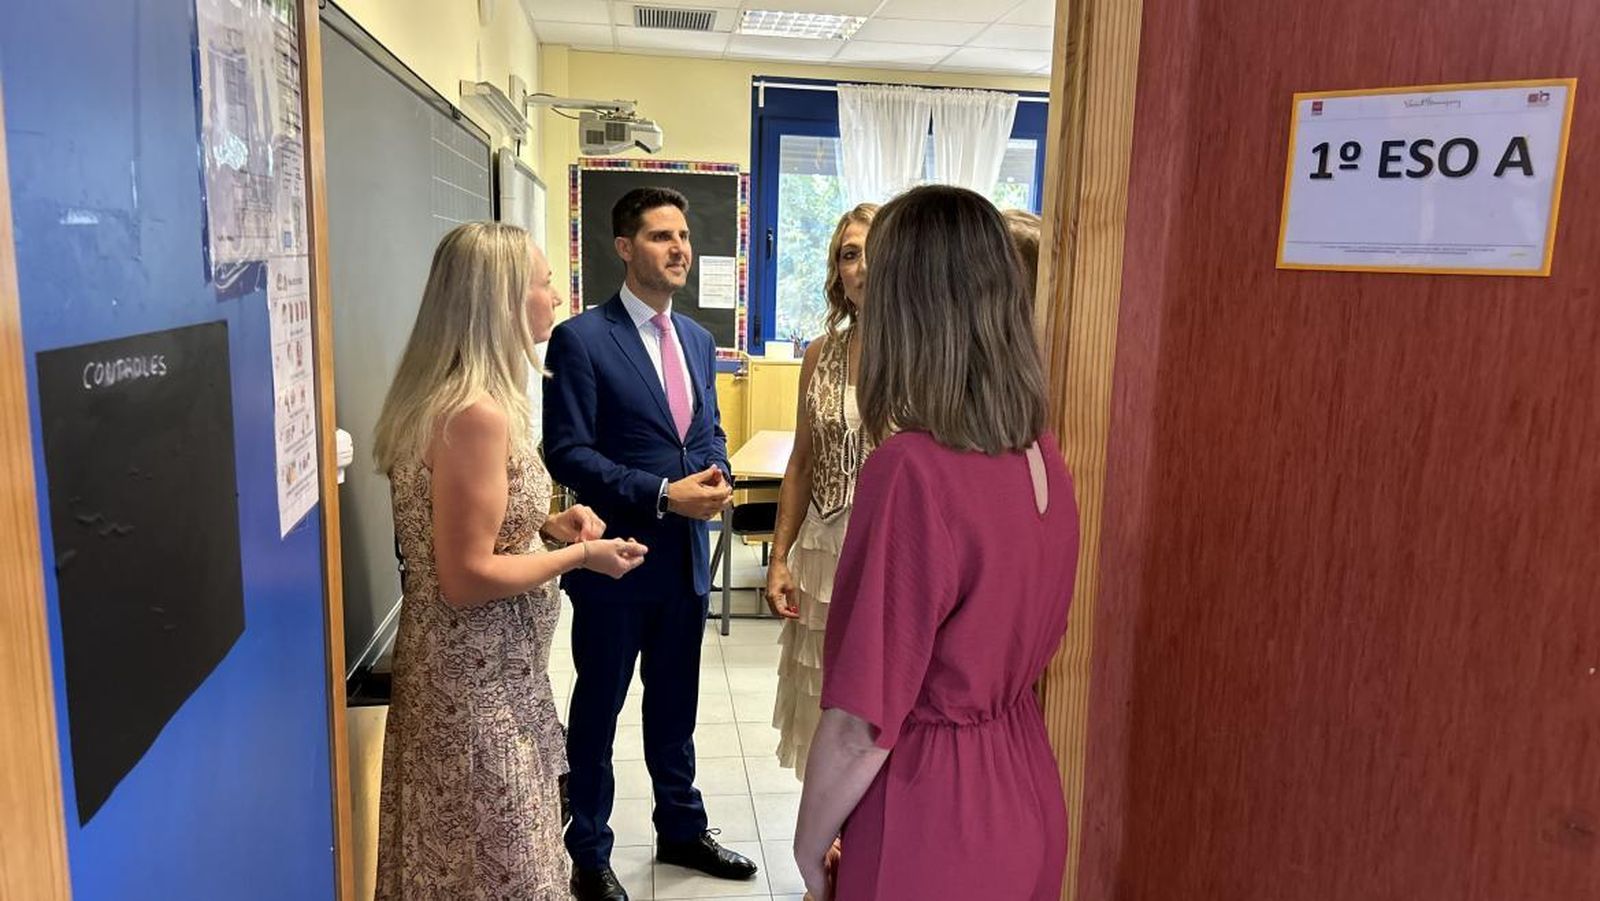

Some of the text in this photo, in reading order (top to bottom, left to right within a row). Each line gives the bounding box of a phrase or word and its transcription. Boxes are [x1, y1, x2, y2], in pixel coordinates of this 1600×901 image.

[1310, 136, 1534, 180] 1º ESO A
